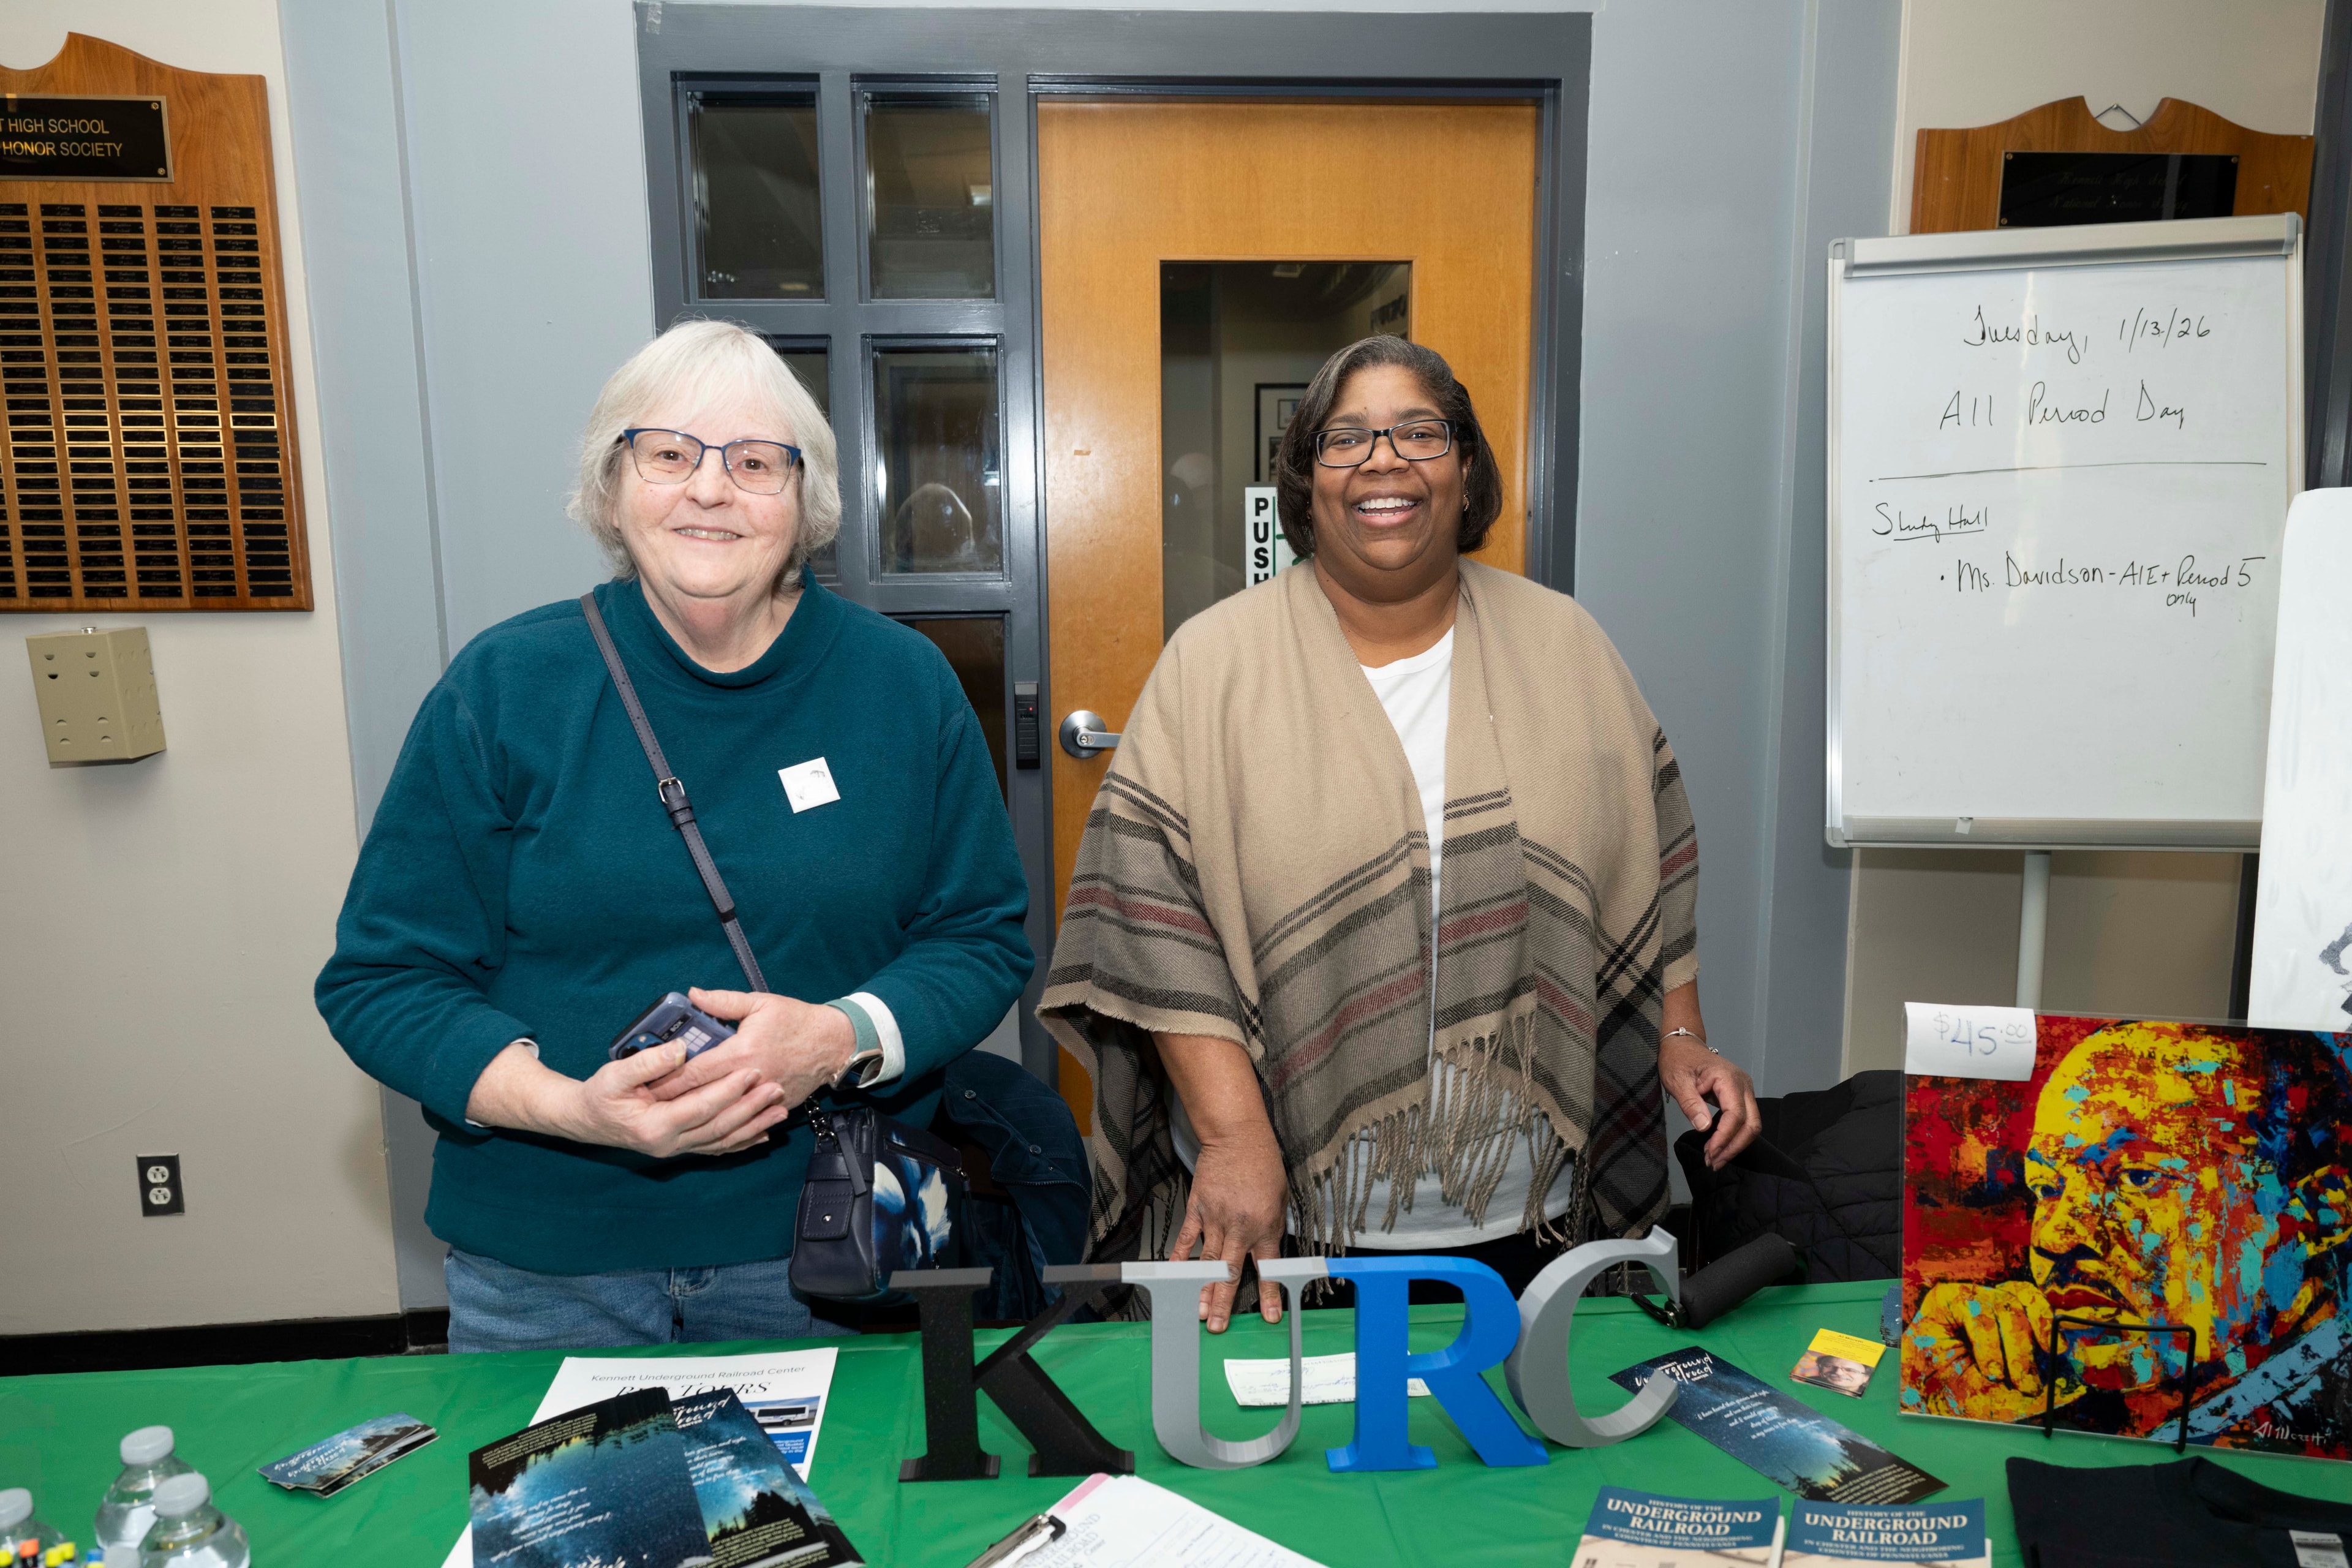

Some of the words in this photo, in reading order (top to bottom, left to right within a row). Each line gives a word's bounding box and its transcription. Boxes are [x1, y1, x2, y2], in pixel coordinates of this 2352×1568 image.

[8, 118, 44, 133] HIGH
[48, 119, 110, 134] SCHOOL
[2, 141, 57, 156] HONOR
[60, 142, 123, 157] SOCIETY
[1964, 305, 2087, 364] Tuesday,
[2120, 307, 2211, 353] 1/13/26
[1940, 390, 1992, 430] All
[2029, 382, 2109, 425] Period
[2136, 380, 2185, 429] Day
[1872, 503, 1941, 543] Study
[1949, 506, 1987, 530] Hall
[1254, 497, 1269, 586] PUSH
[1958, 559, 1995, 592] Ms.
[2177, 554, 2231, 589] Period
[2237, 556, 2266, 587] 5
[2166, 592, 2197, 617] only
[639, 1373, 715, 1382] Underground
[718, 1370, 764, 1378] Railroad
[1635, 1353, 1713, 1387] Unrground
[1607, 1498, 1762, 1523] UNDERGROUND
[1648, 1499, 1689, 1510] HISTORY
[1629, 1515, 1730, 1536] RAILROAD
[1805, 1513, 1967, 1531] UNDERGROUND
[1832, 1529, 1938, 1545] RAILROAD
